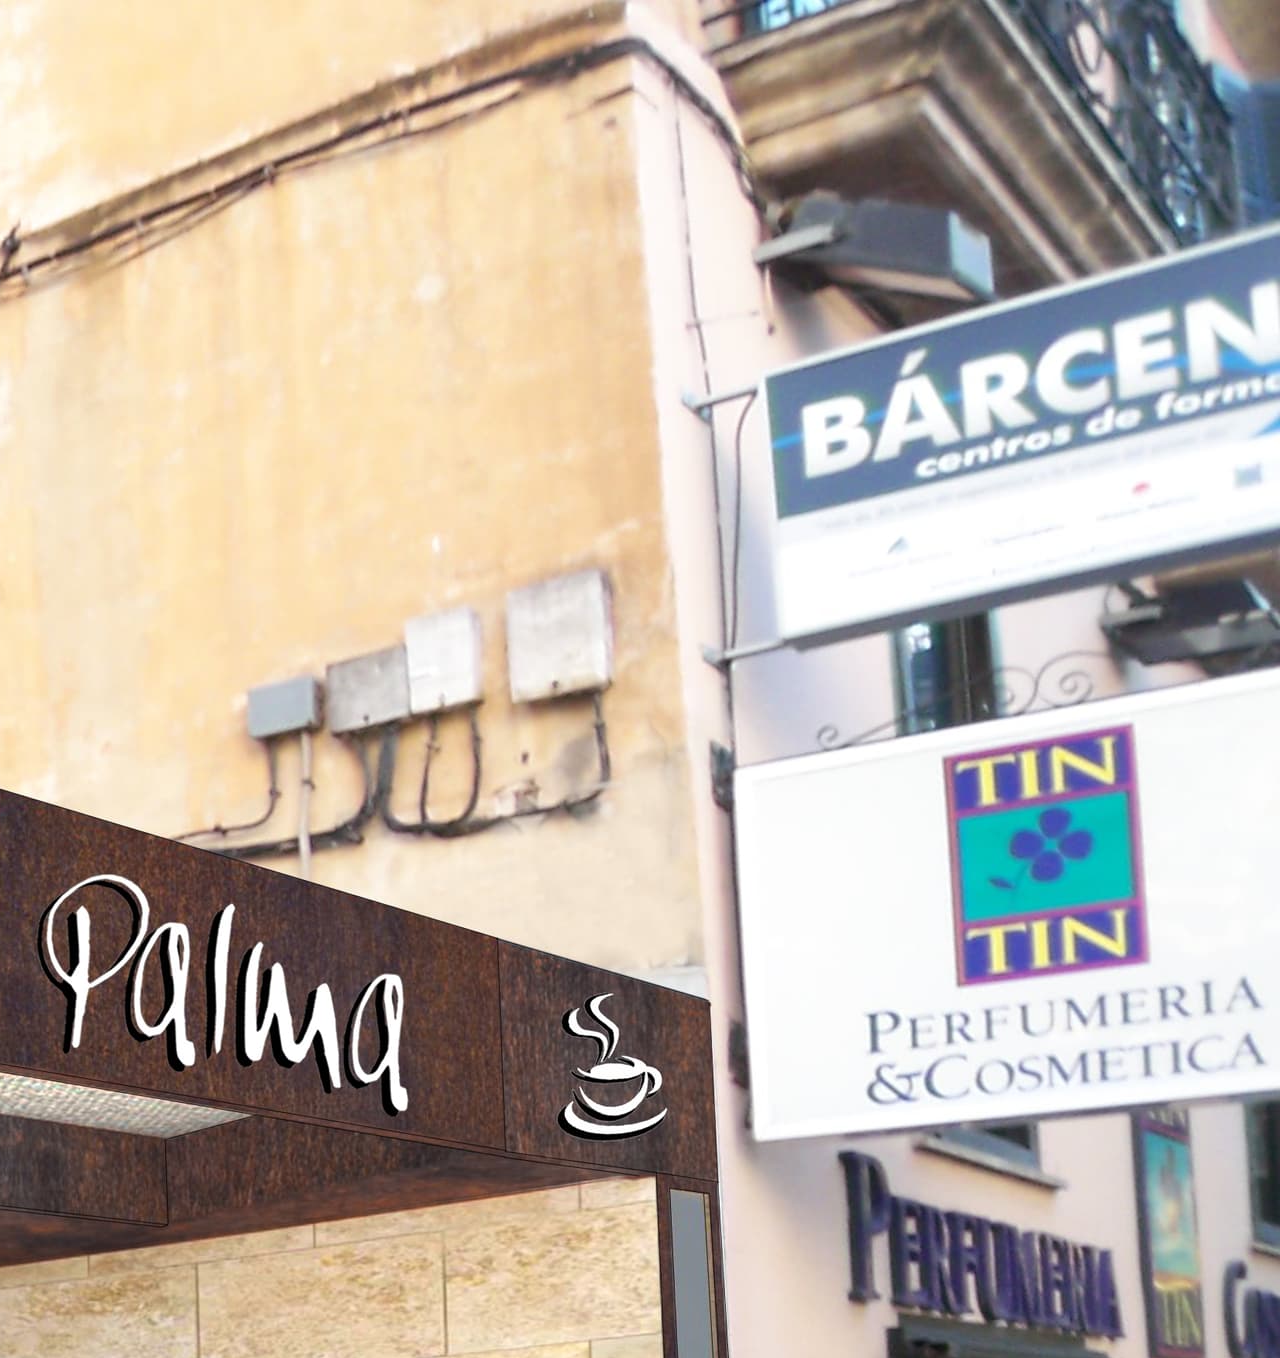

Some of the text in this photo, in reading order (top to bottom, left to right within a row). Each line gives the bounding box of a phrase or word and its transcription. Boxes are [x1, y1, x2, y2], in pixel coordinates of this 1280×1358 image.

[801, 281, 1280, 479] BÁRCEN
[914, 424, 1072, 479] centros
[1085, 405, 1143, 438] de
[955, 735, 1118, 808] TIN
[966, 908, 1131, 975] TIN
[42, 874, 409, 1113] Palma
[864, 976, 1264, 1055] PERFUMERIA
[838, 1150, 1125, 1339] PERFUMERIA
